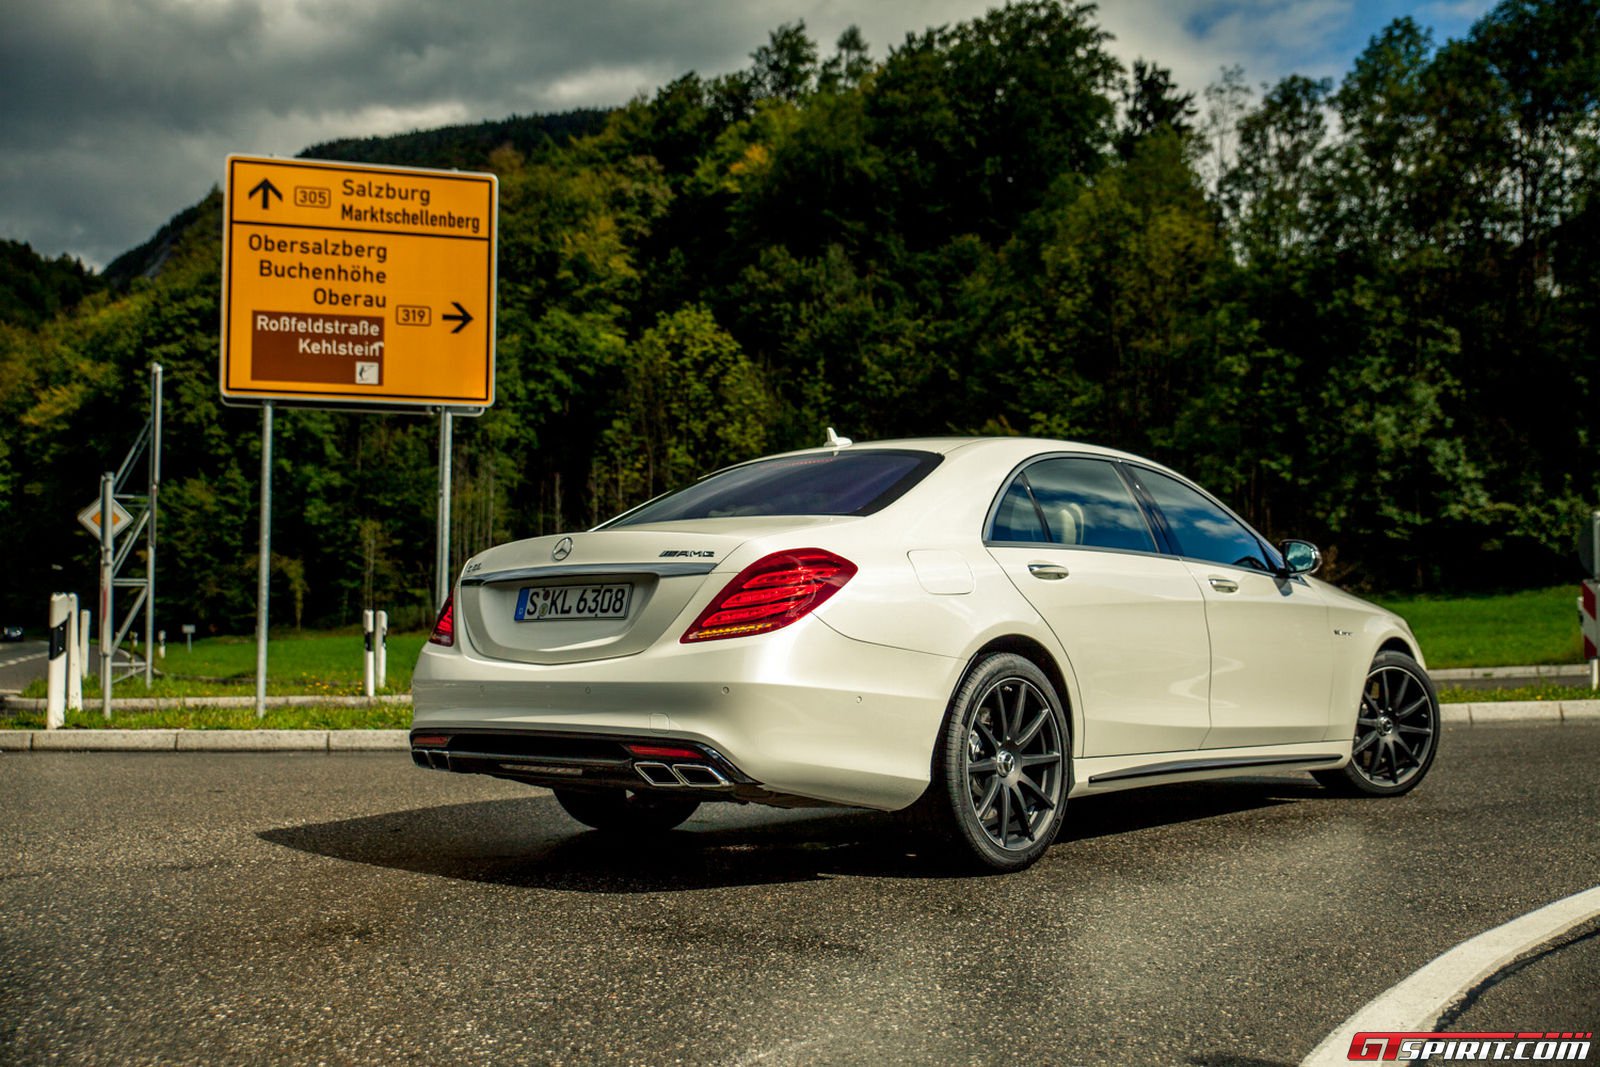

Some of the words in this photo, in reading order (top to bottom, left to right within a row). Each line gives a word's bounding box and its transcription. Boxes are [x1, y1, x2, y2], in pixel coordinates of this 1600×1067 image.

[299, 190, 327, 205] 305
[342, 179, 431, 206] Salzburg
[340, 203, 480, 233] Marktschellenberg
[249, 234, 387, 263] Obersalzberg
[259, 260, 387, 283] Buchenhöhe
[313, 288, 387, 308] Oberau
[256, 315, 380, 337] Roßfeldstraße
[401, 309, 426, 323] 319
[298, 338, 380, 357] Kehlstein
[676, 550, 715, 558] AMG
[526, 591, 540, 616] S
[548, 589, 572, 615] KL
[576, 588, 626, 614] 6308
